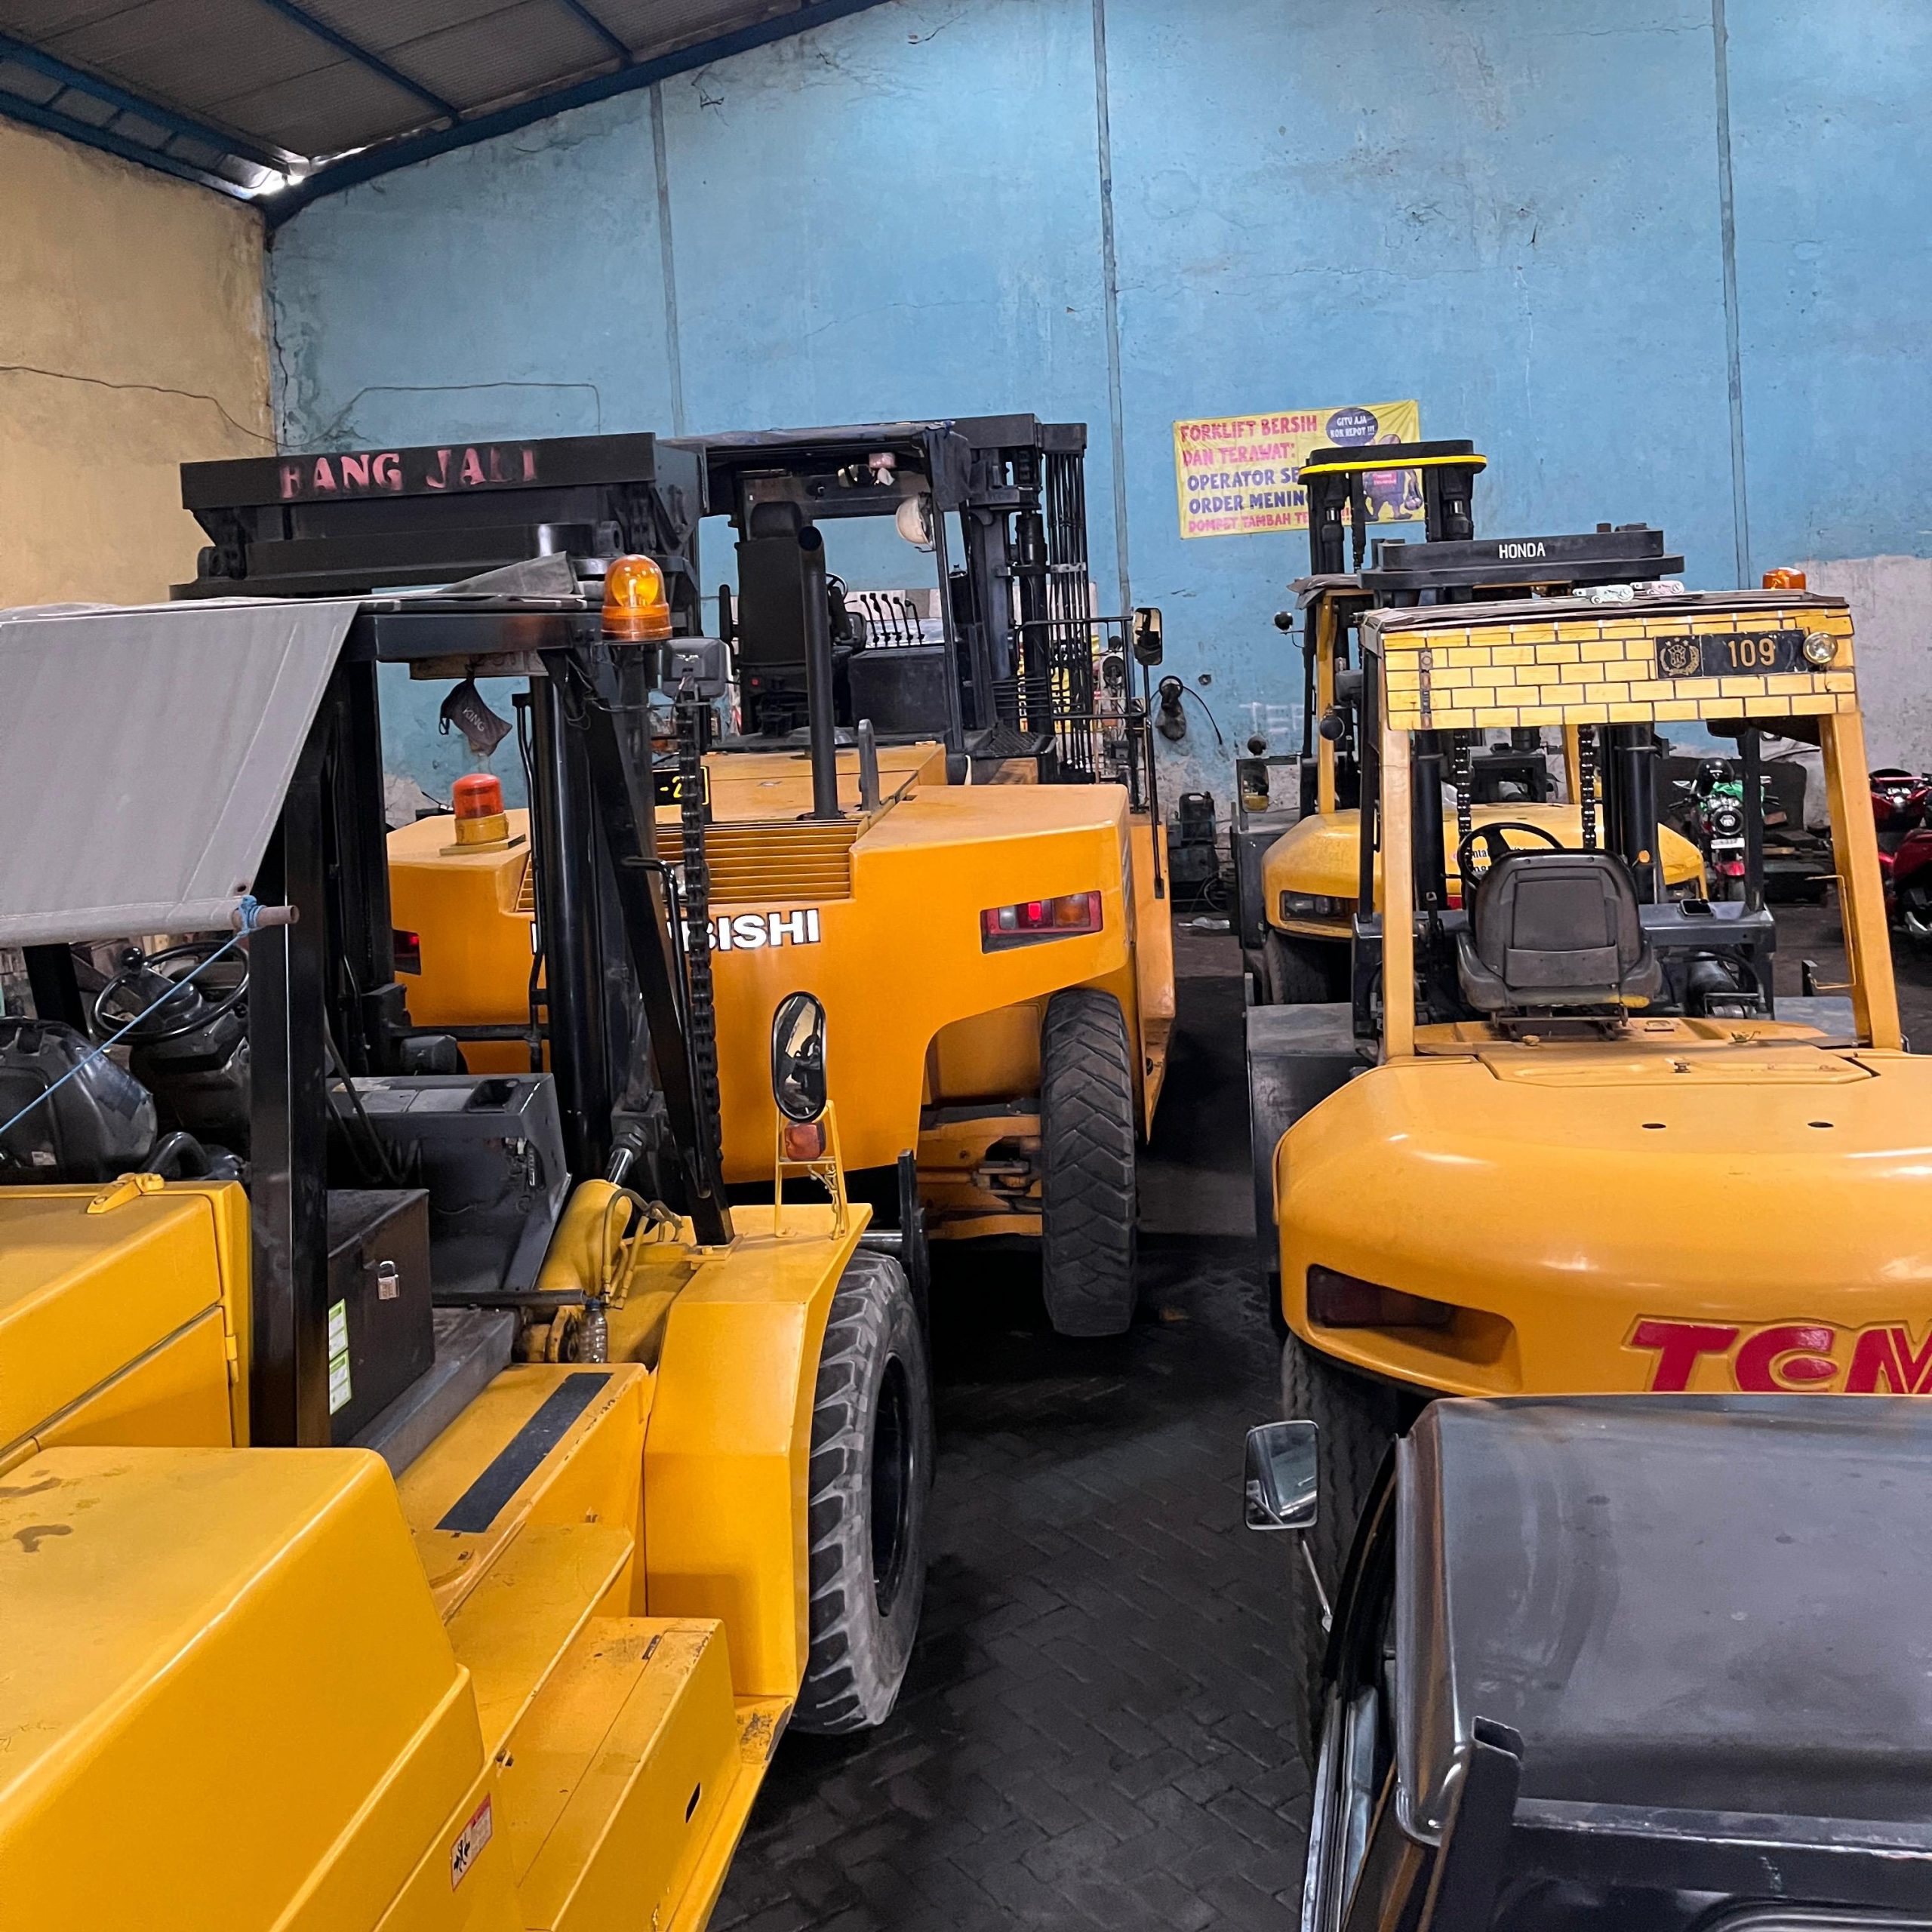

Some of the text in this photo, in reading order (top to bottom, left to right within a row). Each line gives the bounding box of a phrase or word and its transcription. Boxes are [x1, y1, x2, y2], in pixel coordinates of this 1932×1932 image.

[1180, 416, 1317, 442] FORKLIFT BERSIH
[1337, 416, 1367, 426] GITU AJA
[1183, 449, 1213, 466] DAN
[1187, 469, 1275, 491] OPERATOR
[1189, 491, 1305, 514] ORDER MENIN
[1241, 512, 1291, 528] TAMBAH
[1499, 542, 1546, 558] HONDA
[1727, 638, 1775, 668] 109
[462, 707, 485, 732] KING
